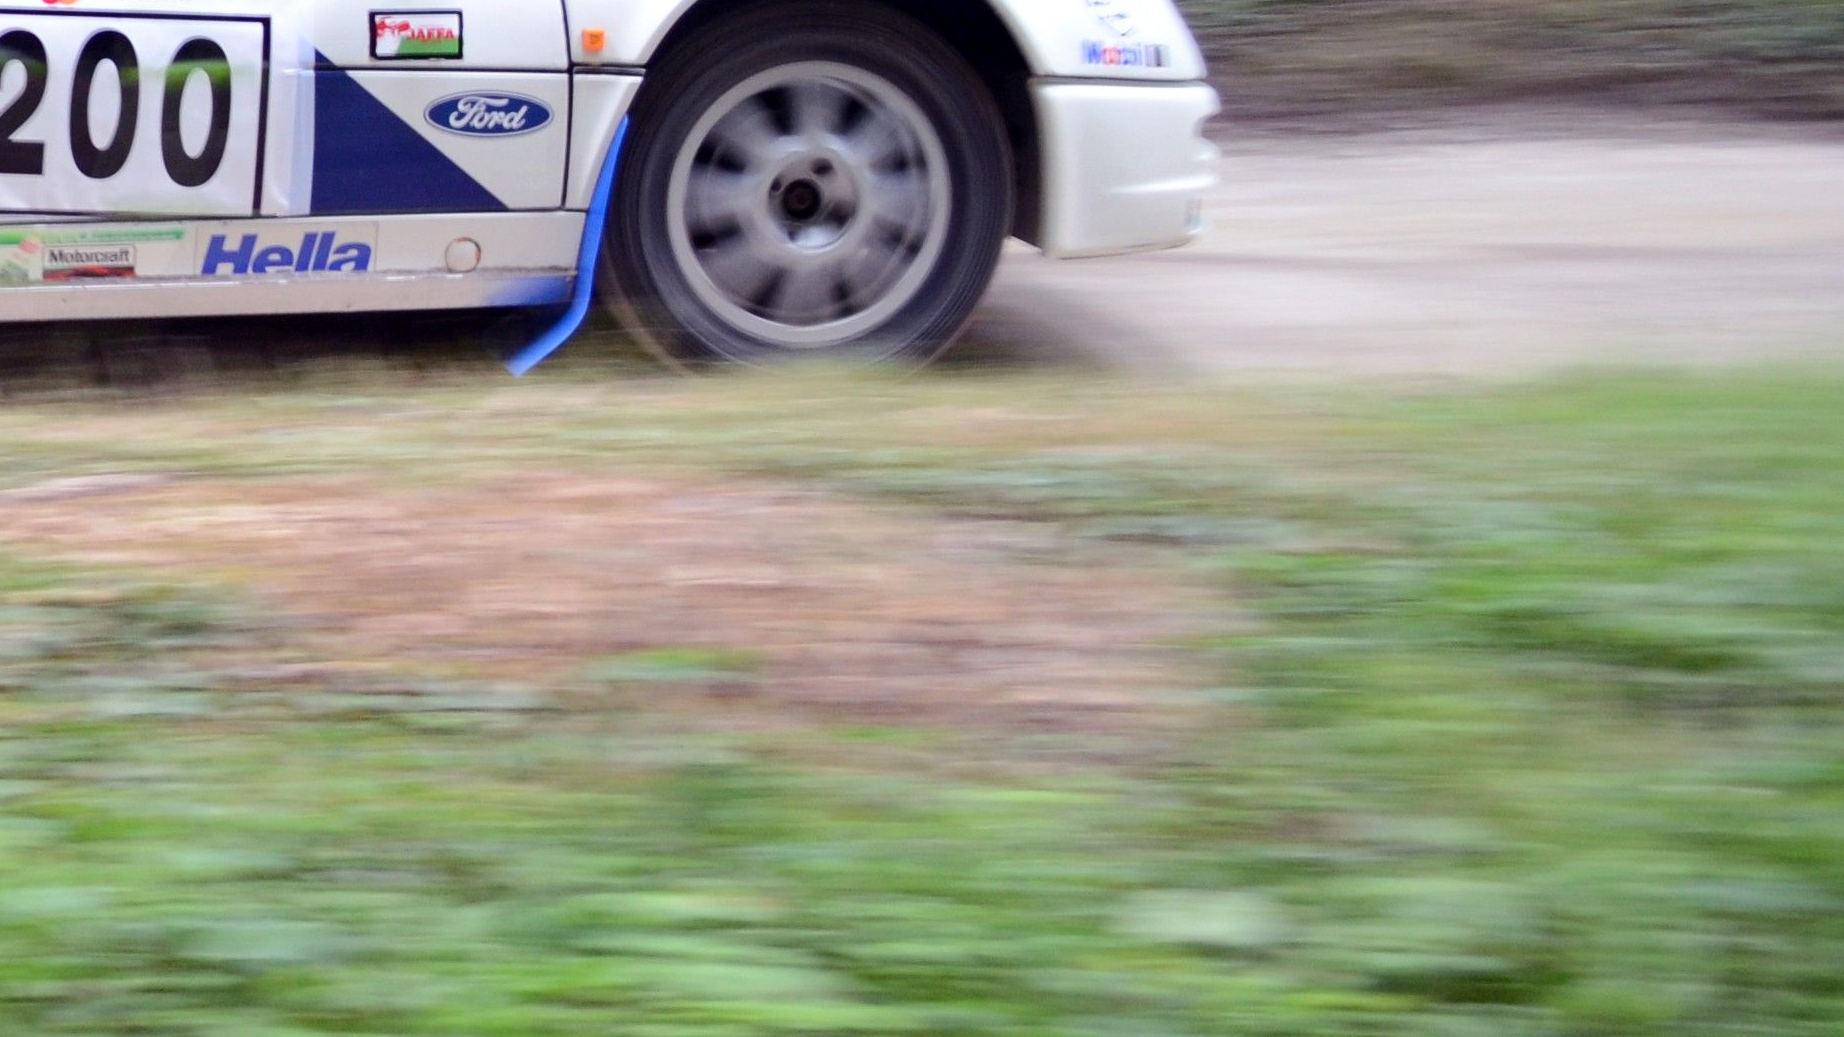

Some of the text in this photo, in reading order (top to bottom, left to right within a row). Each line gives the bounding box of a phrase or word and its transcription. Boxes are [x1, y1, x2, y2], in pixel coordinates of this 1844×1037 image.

[448, 95, 529, 130] Ford
[48, 246, 130, 264] Motorcraft
[201, 231, 373, 276] Hella
